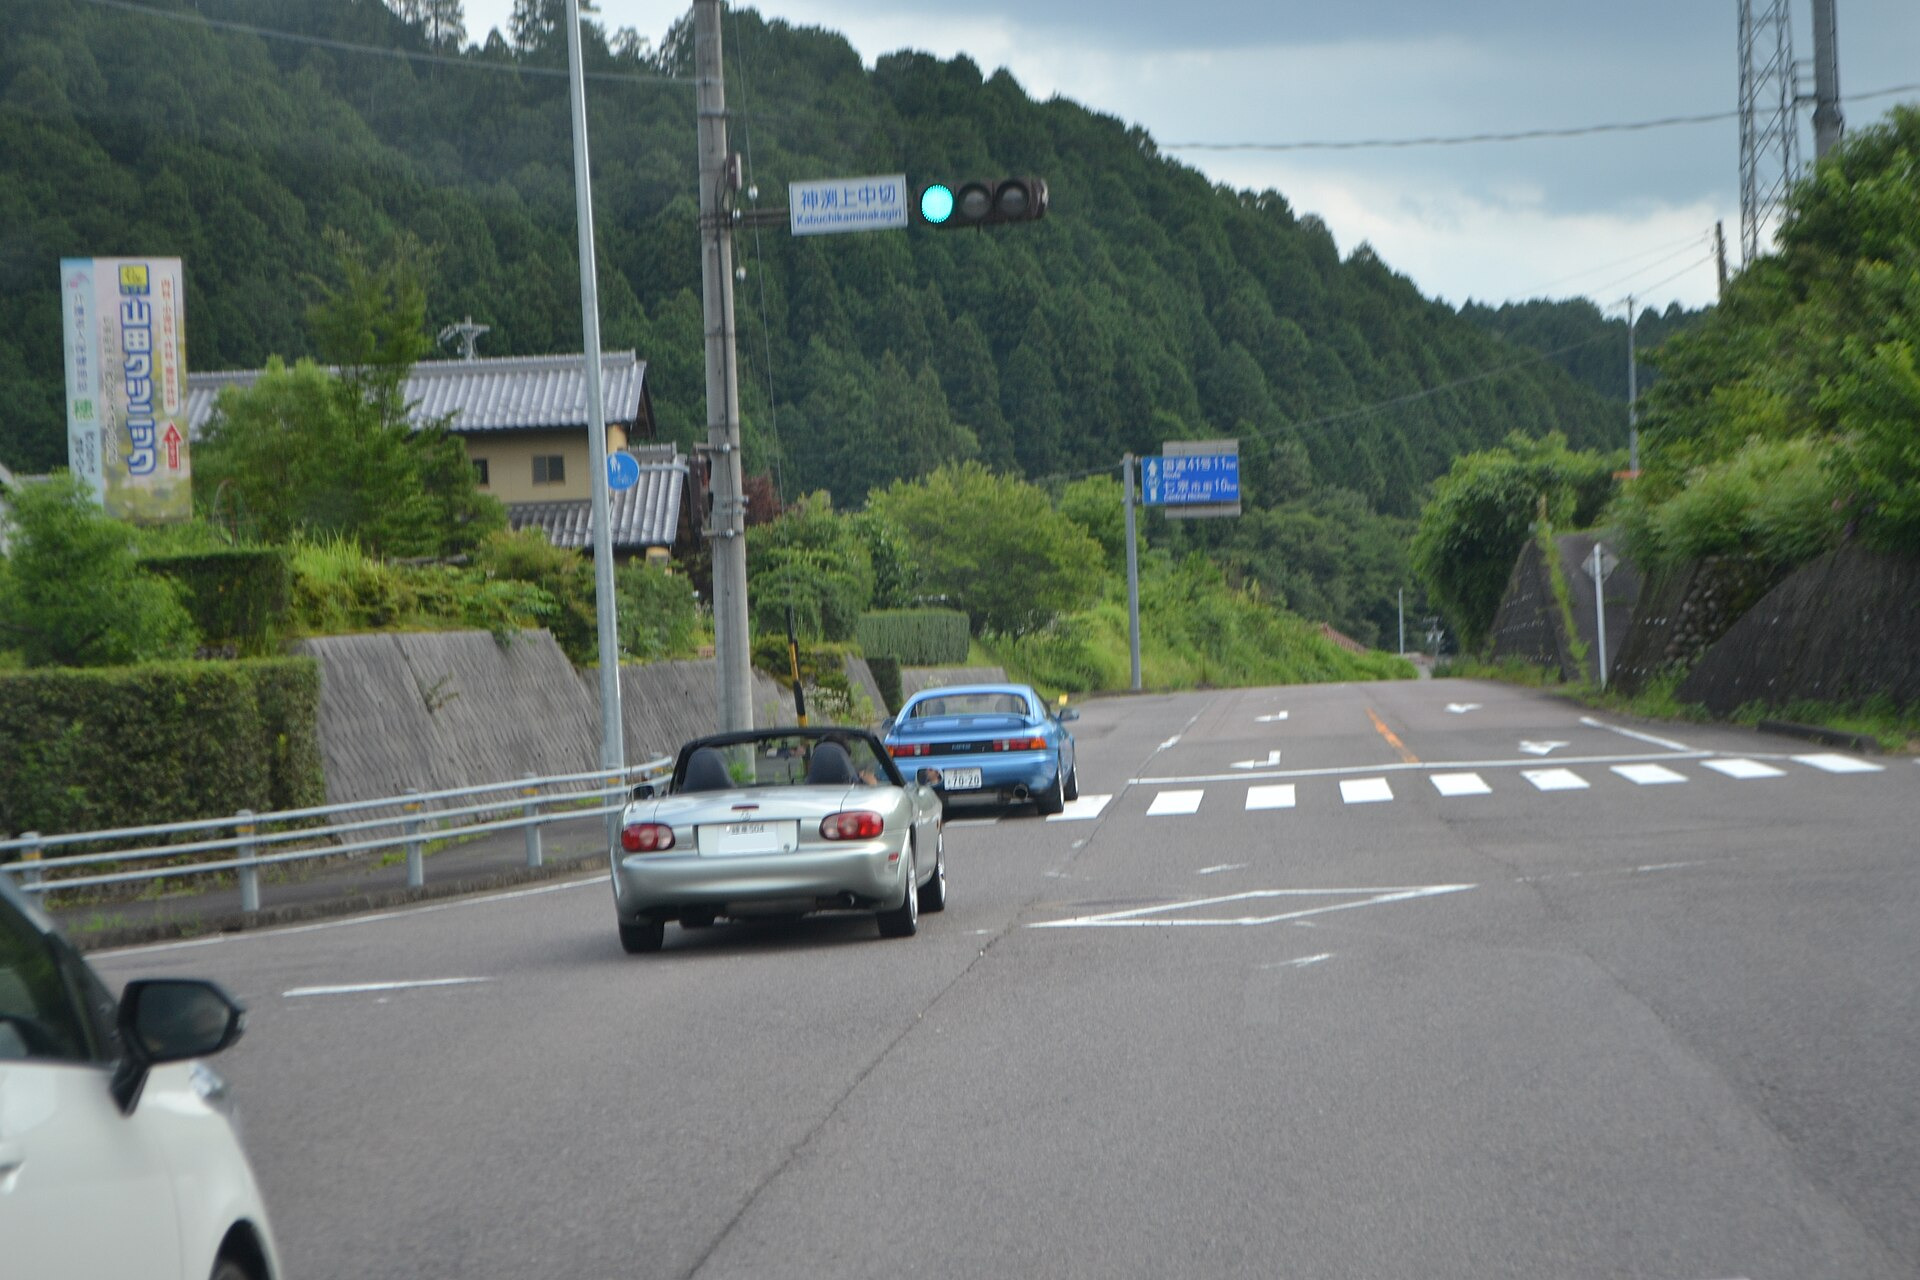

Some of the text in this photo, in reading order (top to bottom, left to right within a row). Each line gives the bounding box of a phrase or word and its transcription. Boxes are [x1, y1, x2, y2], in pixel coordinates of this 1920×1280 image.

[797, 208, 902, 227] Kabuchikaminakagiri
[120, 297, 156, 476] 山田クリニック
